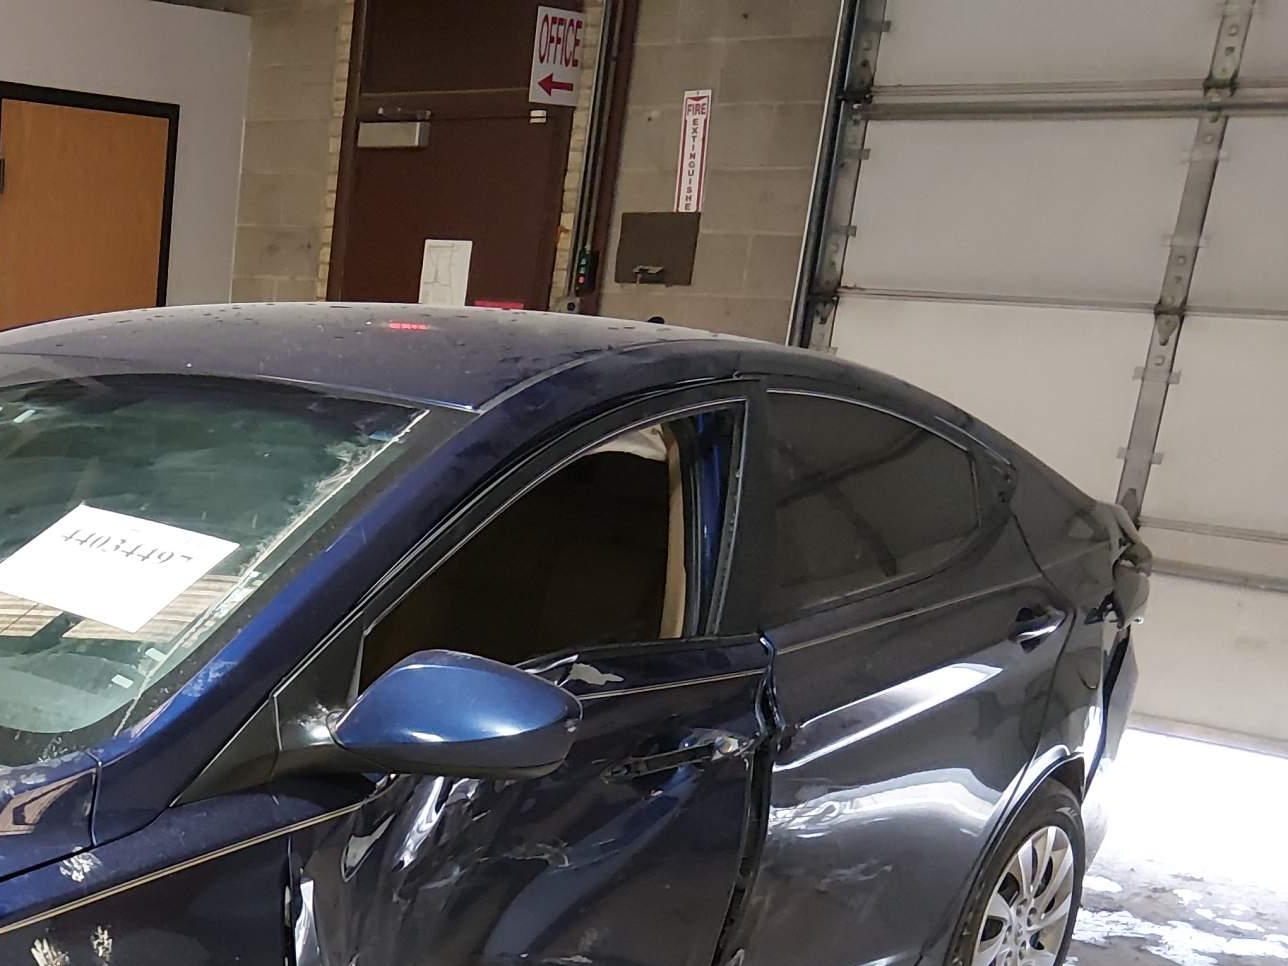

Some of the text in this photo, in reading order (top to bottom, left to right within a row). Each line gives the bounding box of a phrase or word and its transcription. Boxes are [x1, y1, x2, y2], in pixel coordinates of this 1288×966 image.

[538, 13, 583, 67] OFFICE
[686, 102, 707, 116] FIRE
[684, 118, 699, 211] EXTINGUISHE
